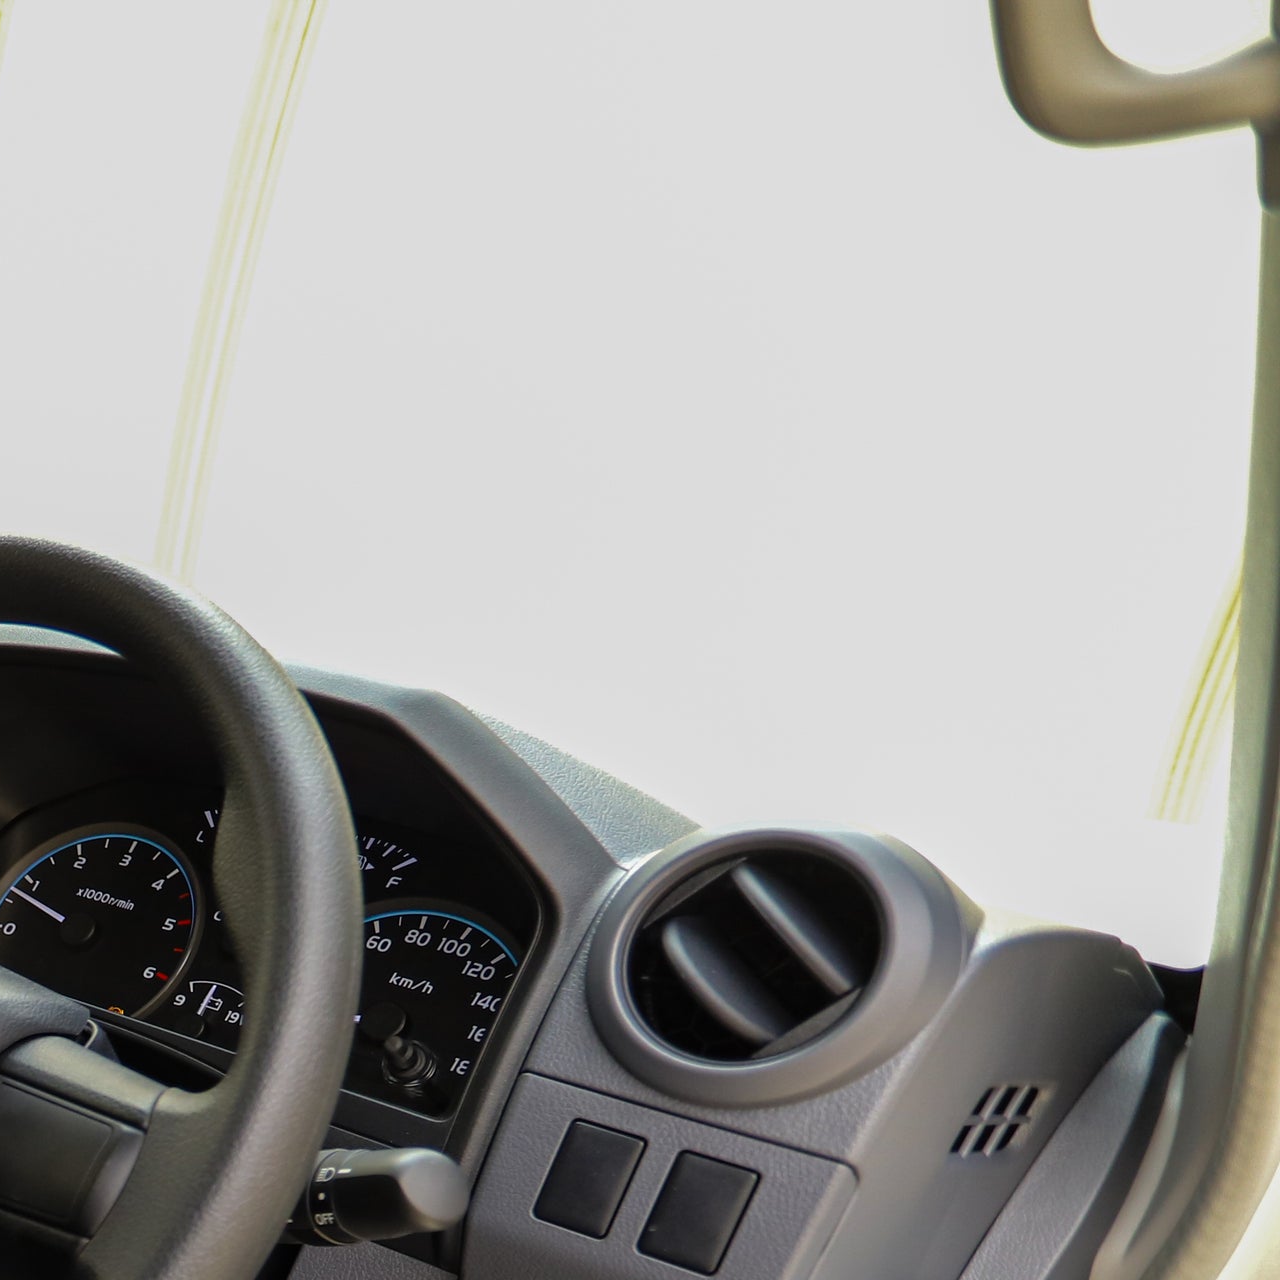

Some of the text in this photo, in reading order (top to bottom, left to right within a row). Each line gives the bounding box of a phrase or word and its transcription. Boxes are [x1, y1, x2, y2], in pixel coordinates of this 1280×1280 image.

[73, 856, 87, 869] 2
[118, 855, 132, 867] 3
[31, 880, 40, 892] 1
[151, 878, 165, 891] 4
[385, 877, 402, 888] F
[2, 923, 16, 935] 0
[161, 918, 177, 931] 5
[366, 936, 391, 952] 60
[404, 930, 431, 946] 80
[437, 938, 471, 957] 100
[142, 967, 156, 979] 6
[461, 961, 495, 980] 120
[389, 973, 434, 994] km/h
[173, 995, 186, 1006] 9
[314, 1213, 335, 1225] OFF
